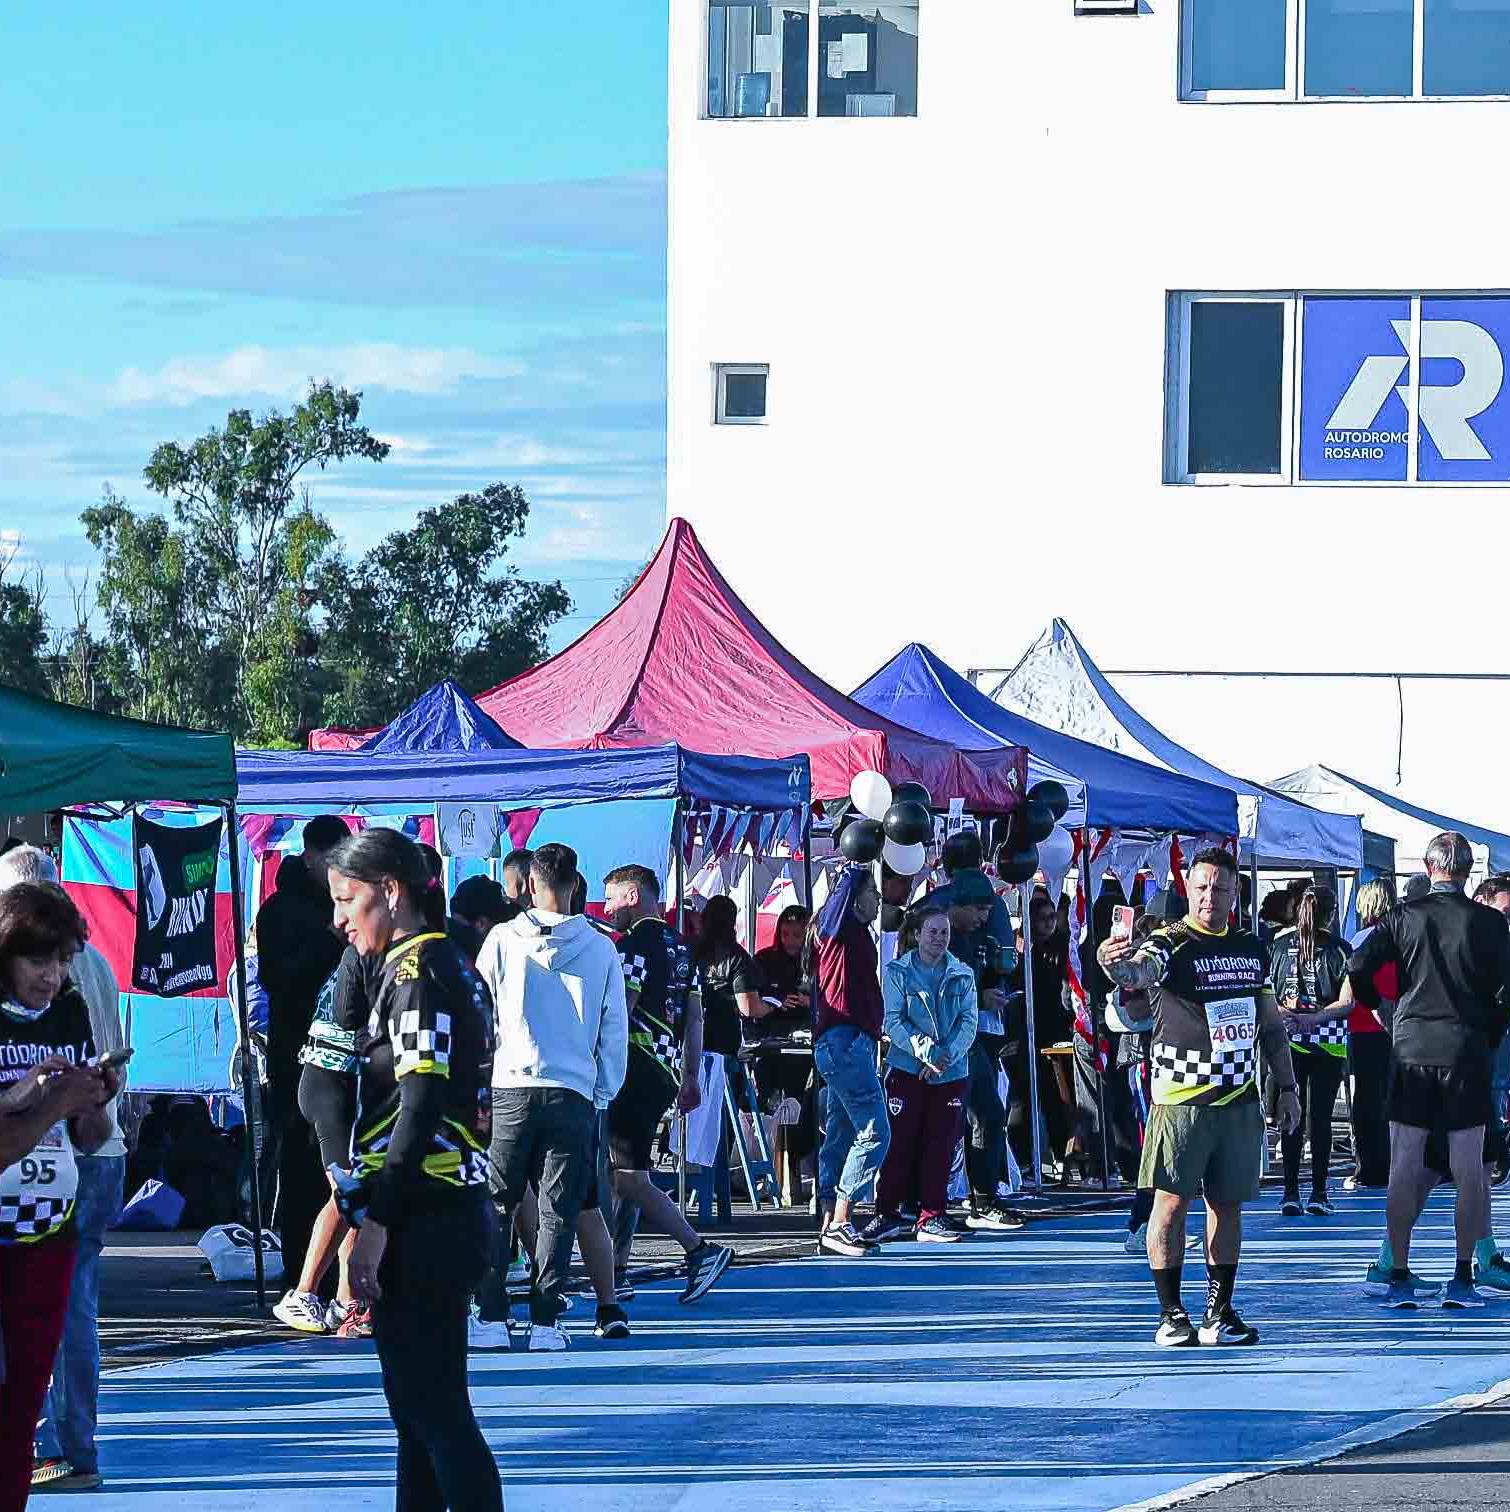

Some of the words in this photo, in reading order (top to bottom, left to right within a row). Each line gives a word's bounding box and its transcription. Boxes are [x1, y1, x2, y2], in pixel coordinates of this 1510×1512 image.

[1324, 447, 1384, 459] ROSARIO
[1213, 1023, 1254, 1043] 4065
[19, 1158, 57, 1185] 95
